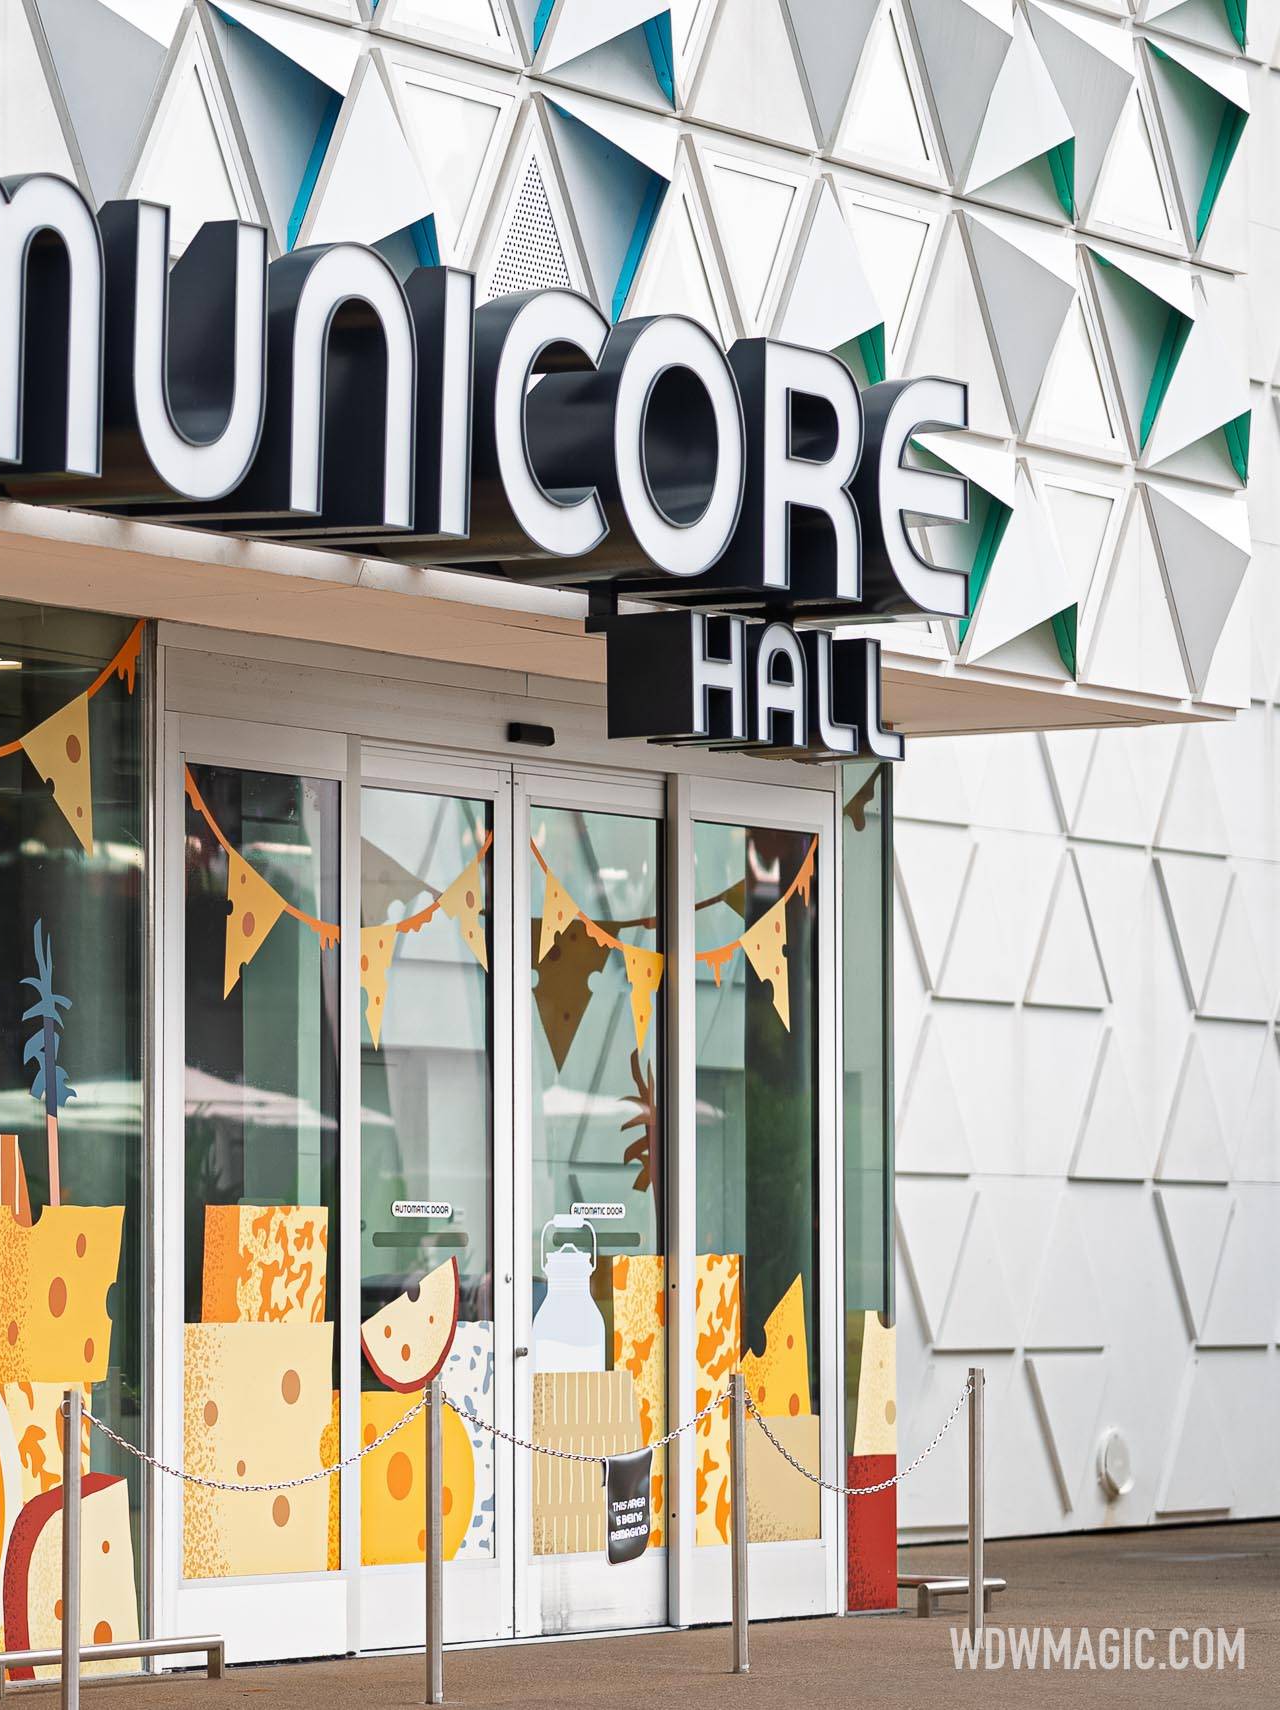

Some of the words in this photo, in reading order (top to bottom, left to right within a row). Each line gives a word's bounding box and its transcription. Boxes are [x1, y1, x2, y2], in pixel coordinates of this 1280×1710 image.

[691, 609, 905, 762] HALL
[394, 1204, 430, 1215] AUTOMATIC
[431, 1205, 450, 1216] DOOR
[573, 1206, 605, 1216] AUTOMATIC
[606, 1206, 624, 1216] DOOR
[612, 1502, 627, 1512] THIS
[627, 1497, 646, 1510] AREA
[616, 1515, 622, 1526] IS
[622, 1512, 643, 1525] BEING
[610, 1525, 648, 1541] REIMAGINED
